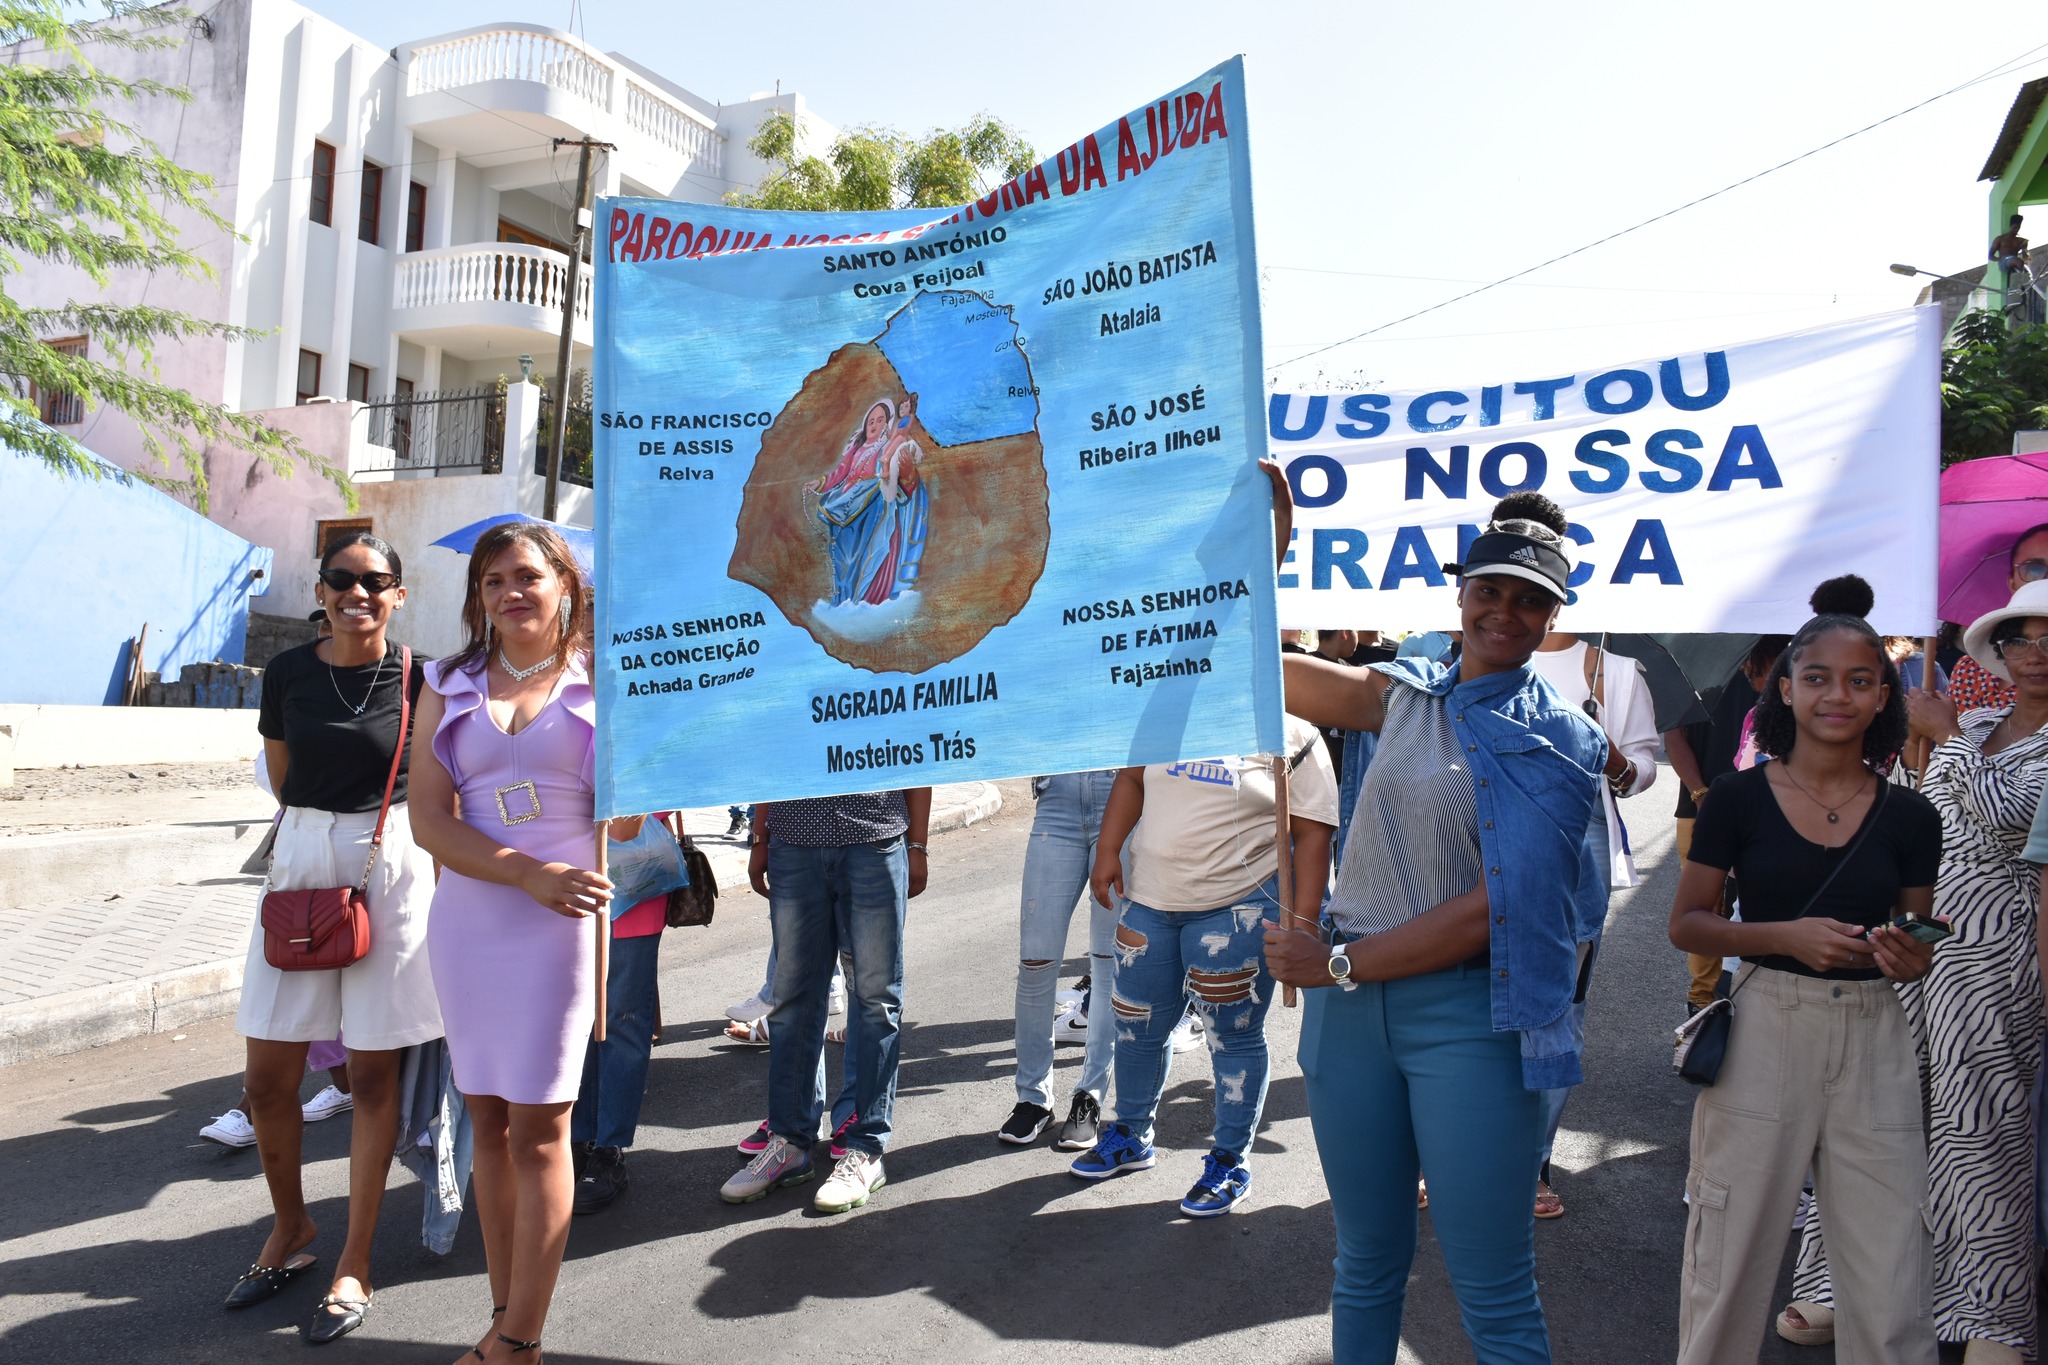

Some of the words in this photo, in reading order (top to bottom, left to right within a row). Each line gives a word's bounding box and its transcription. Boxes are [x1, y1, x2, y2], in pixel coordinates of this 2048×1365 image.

[1056, 132, 1108, 197] DA
[1117, 81, 1228, 182] AJUDA
[823, 249, 896, 274] SANTO
[904, 226, 1008, 264] ANTÓNIO
[853, 280, 907, 299] Cova
[912, 260, 985, 289] Feijoal
[1042, 278, 1075, 306] SÃO
[1081, 261, 1133, 296] JOÃO
[1138, 240, 1217, 285] BATISTA
[1100, 303, 1161, 337] Atalaia
[995, 336, 1026, 353] Coro
[1008, 385, 1041, 397] Relva
[1091, 403, 1137, 432] SÃO
[1143, 384, 1206, 421] JOSÉ
[600, 411, 644, 430] SÃO
[651, 411, 772, 430] FRANCISCO
[639, 441, 666, 456] DE
[672, 439, 734, 456] ASSIS
[1079, 441, 1158, 471] Ribeira
[1164, 425, 1221, 453] Ilheu
[659, 466, 714, 481] Relva
[1271, 453, 1348, 509] O
[1405, 424, 1784, 502] NOSSA
[1509, 553, 1539, 567] adidas
[1062, 599, 1136, 626] NOSSA
[1141, 579, 1251, 614] SENHORA
[611, 624, 668, 647] NOSSA
[672, 611, 767, 638] SENHORA
[1101, 633, 1128, 654] DE
[1135, 619, 1218, 648] FÁTIMA
[621, 654, 647, 671] DA
[650, 637, 761, 663] CONCEIÇÃO
[627, 677, 693, 697] Achada
[698, 666, 755, 689] Grande
[811, 686, 907, 723] SAGRADA
[913, 671, 999, 711] FAMILIA
[826, 738, 924, 774] Mosteiros
[929, 730, 977, 762] Trás
